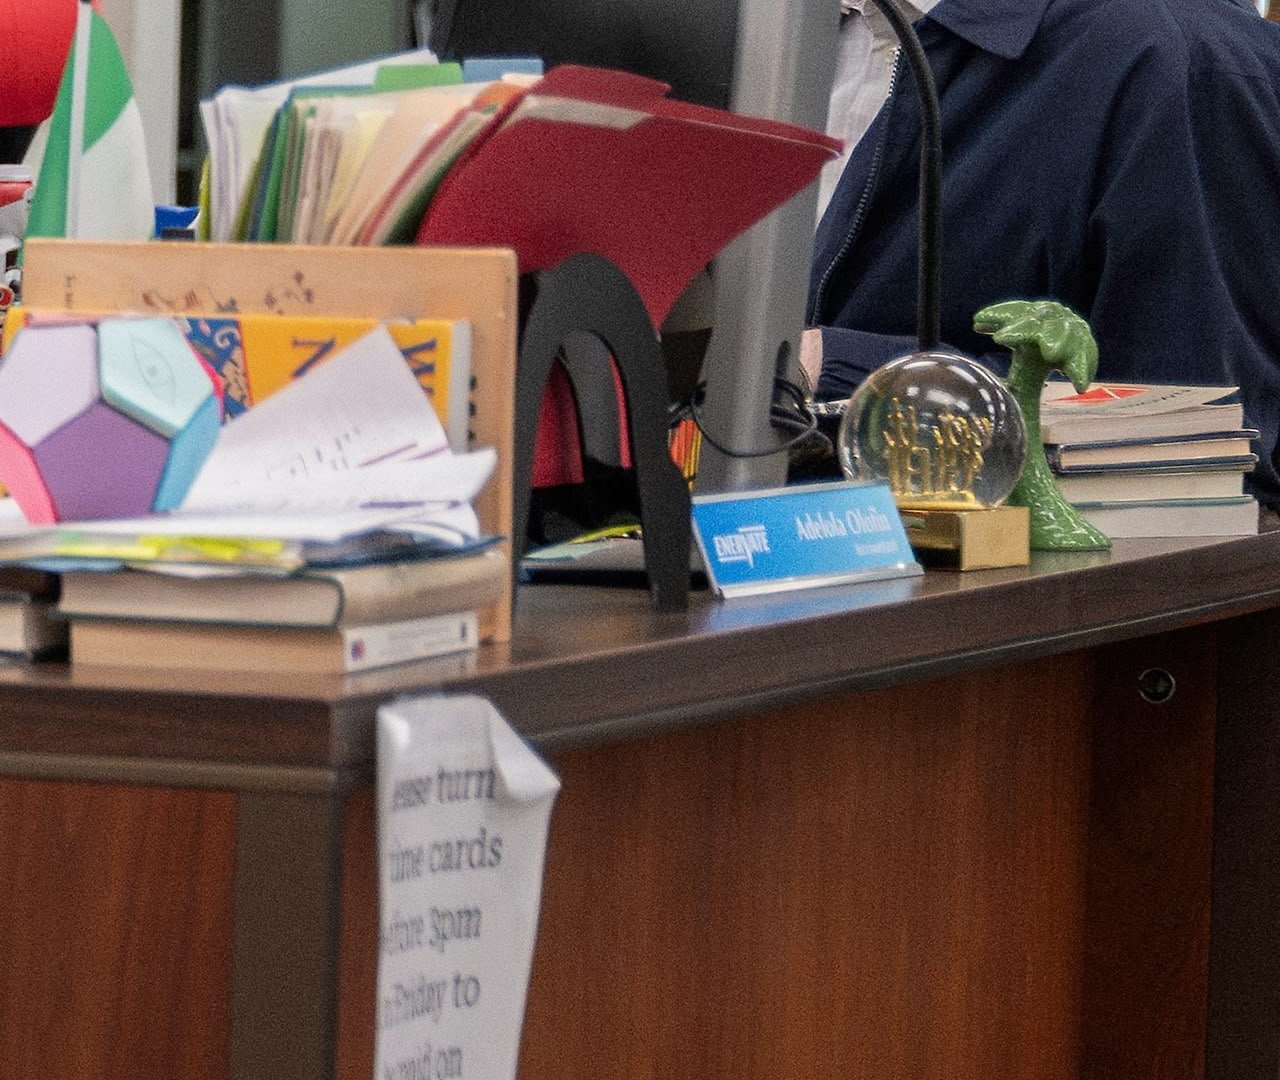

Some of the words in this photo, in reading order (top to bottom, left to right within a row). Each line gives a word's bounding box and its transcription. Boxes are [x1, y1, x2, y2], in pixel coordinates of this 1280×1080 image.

[436, 765, 496, 803] turn
[428, 825, 503, 874] cards
[430, 904, 482, 954] 3pm
[453, 972, 481, 1010] to
